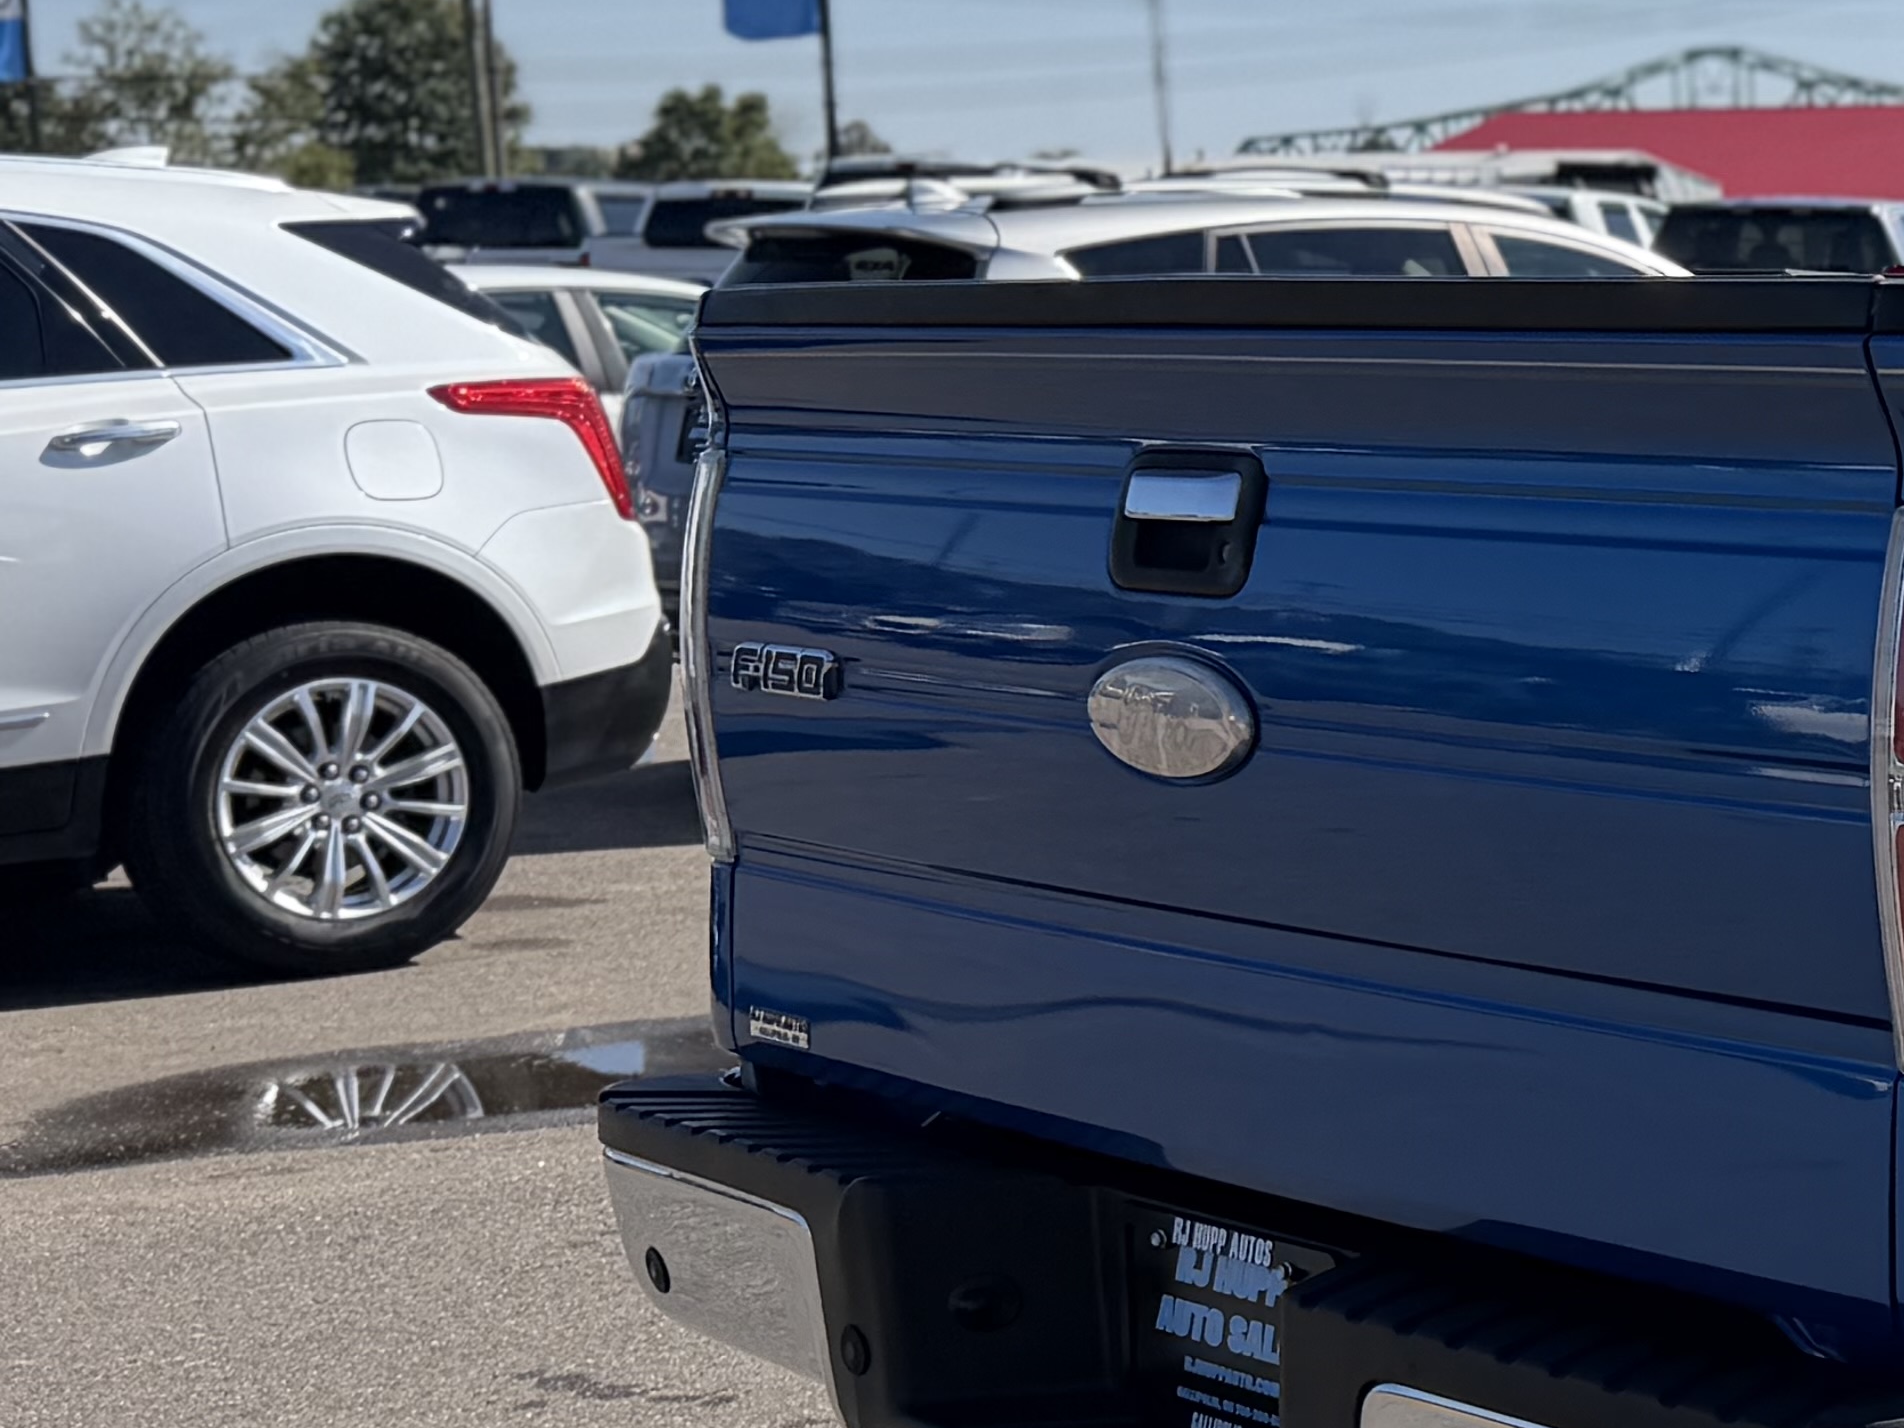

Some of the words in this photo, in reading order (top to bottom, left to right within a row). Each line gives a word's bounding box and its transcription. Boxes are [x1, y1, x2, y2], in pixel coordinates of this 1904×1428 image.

[1172, 1216, 1191, 1247] RJ
[1192, 1221, 1227, 1255] HUPP
[1229, 1231, 1273, 1267] AUTOS
[1175, 1245, 1214, 1288] RJ
[1155, 1294, 1225, 1348] AUTO
